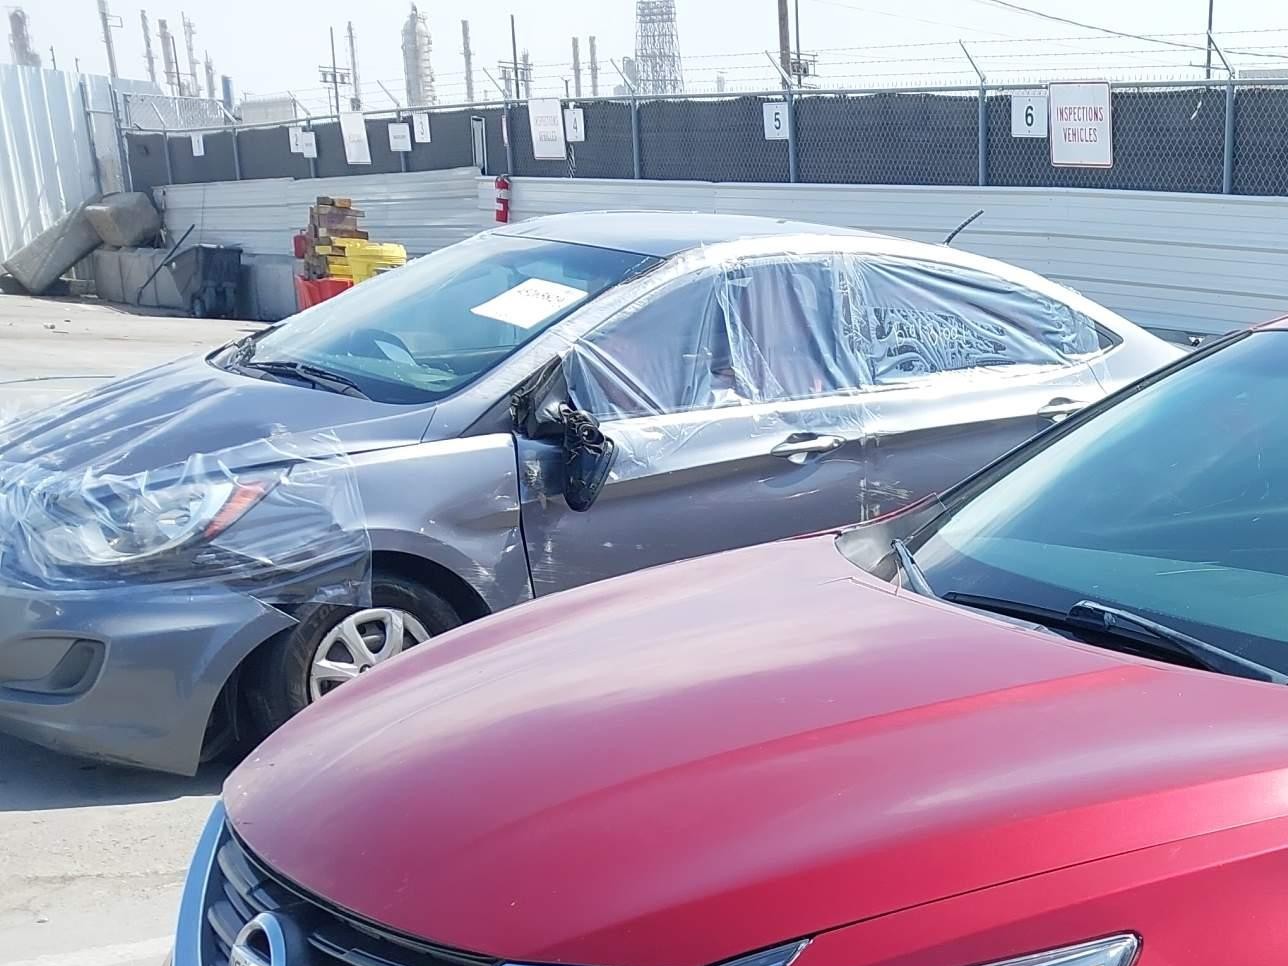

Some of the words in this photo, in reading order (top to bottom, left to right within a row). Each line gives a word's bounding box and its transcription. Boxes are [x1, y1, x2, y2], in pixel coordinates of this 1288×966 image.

[774, 111, 781, 130] 5
[1024, 105, 1034, 127] 6
[1056, 106, 1104, 122] INSPECTIONS
[1062, 127, 1098, 143] VEHICLES
